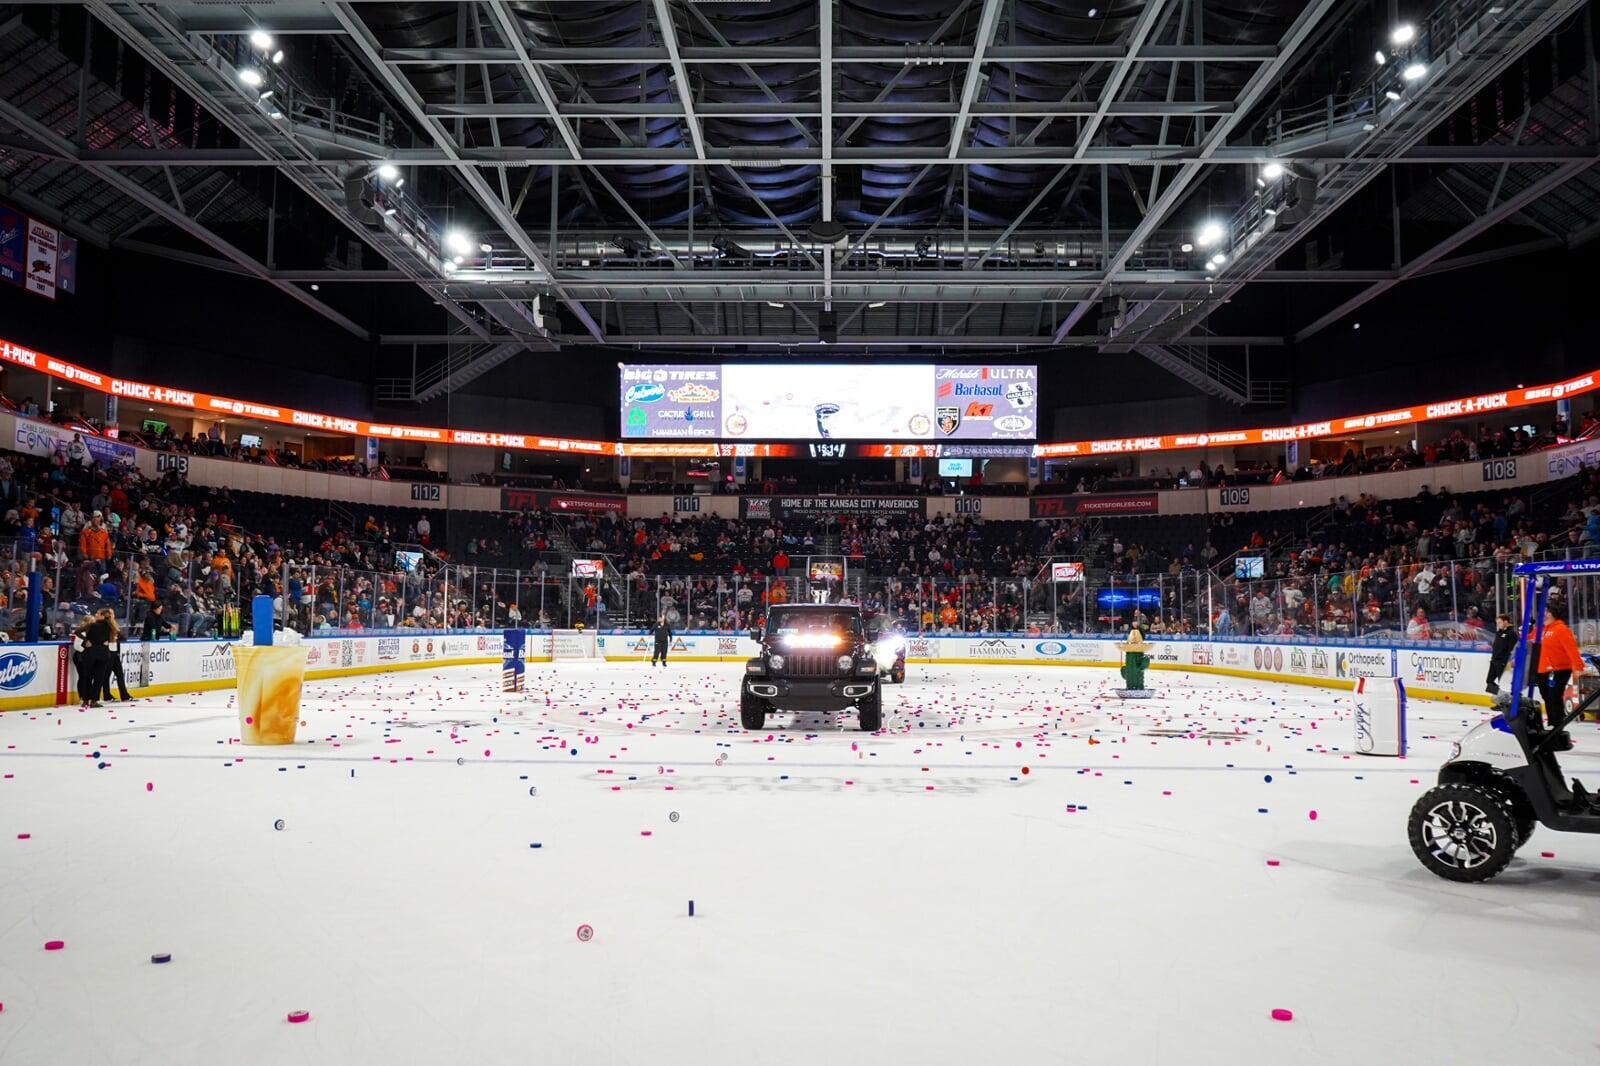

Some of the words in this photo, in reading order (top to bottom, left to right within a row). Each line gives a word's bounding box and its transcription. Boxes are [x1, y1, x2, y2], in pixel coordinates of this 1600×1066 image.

[990, 368, 1035, 379] ULTRA
[111, 379, 195, 407] CHUCK-A-PUCK
[954, 383, 1002, 396] Barbasol
[1426, 394, 1508, 418] CHUCK-A-PUCK
[658, 410, 685, 418] CACTUS
[693, 410, 715, 418] GRILL
[292, 411, 358, 433] CHUCK-A-PUCK
[454, 431, 525, 447] CHUCK-A-PUCK
[1261, 423, 1332, 441] CHUCK-A-PUCK
[16, 430, 68, 451] CONNE
[1091, 437, 1161, 452] CHUCK-A-PUCK
[764, 445, 770, 456] 1
[884, 445, 893, 456] 2
[159, 455, 188, 473] 113
[1484, 460, 1517, 479] 108
[413, 486, 440, 500] 112
[1222, 489, 1249, 504] 109
[676, 498, 699, 511] 111
[781, 499, 802, 508] HOME
[803, 499, 813, 508] OF
[814, 499, 829, 508] THE
[830, 499, 859, 508] KANSAS
[860, 499, 877, 508] CITY
[878, 499, 919, 509] MAVERICKS
[957, 500, 980, 512] 110
[1036, 498, 1068, 516] TFL
[1083, 500, 1152, 510] TICKETSFORLESS.COM
[969, 646, 1017, 656] HAMMONS
[1157, 654, 1178, 662] LOCKTON
[202, 657, 234, 673] HAMMO
[1349, 652, 1385, 667] Orthopedic
[1411, 652, 1462, 673] Community
[1415, 663, 1455, 684] America
